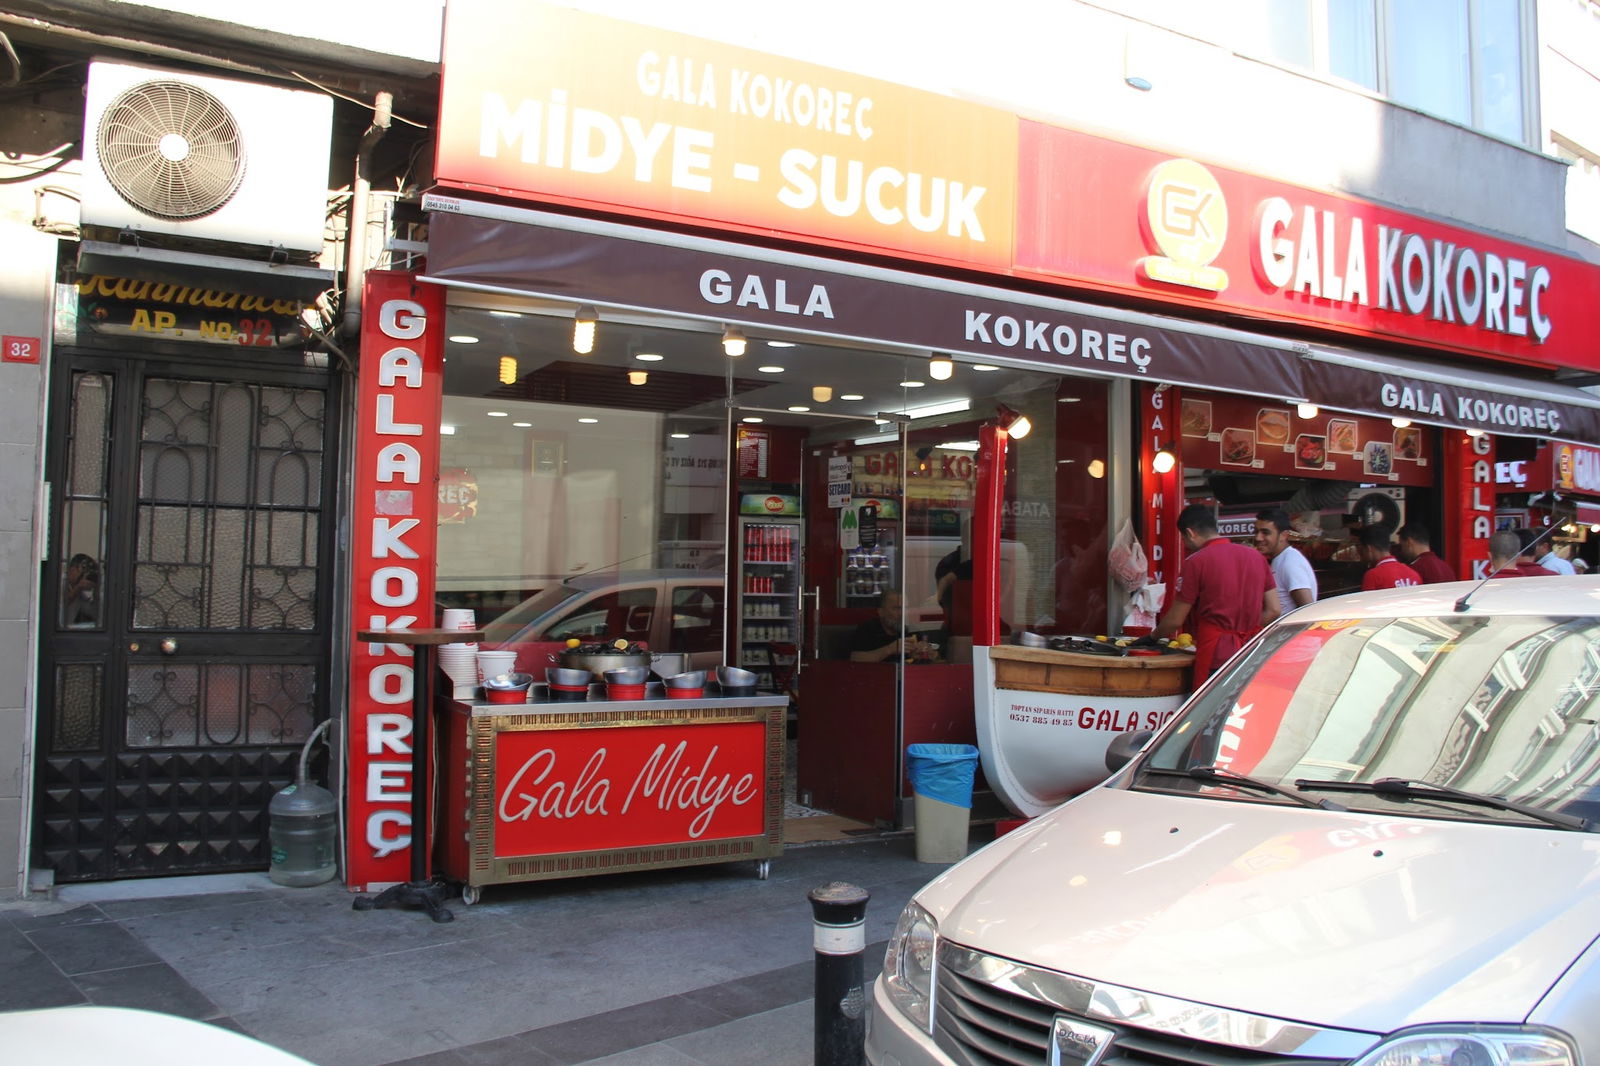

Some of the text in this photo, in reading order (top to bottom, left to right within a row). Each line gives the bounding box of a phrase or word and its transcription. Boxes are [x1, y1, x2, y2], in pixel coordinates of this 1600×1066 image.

[636, 50, 875, 142] GALA KOKOREÇ
[479, 87, 716, 193] MİDYE
[776, 147, 987, 243] SUCUK
[1257, 195, 1552, 345] GALA KOKOREÇ
[10, 342, 31, 357] 32
[130, 308, 184, 337] AP.
[698, 268, 1153, 374] GALA KOKOREÇ
[375, 299, 428, 484] GALA
[1151, 391, 1165, 475] GAL
[1380, 382, 1562, 433] GALA KOKOREÇ
[1472, 433, 1492, 539] GALA
[365, 517, 421, 858] KOKOREÇ
[1009, 713, 1030, 723] 0537
[1032, 716, 1048, 725] 885
[1062, 719, 1074, 727] 85
[1011, 704, 1032, 713] TOPTAN
[1077, 706, 1140, 732] GALA
[499, 739, 758, 840] Gala Midye
[1059, 1028, 1098, 1047] DACIA
